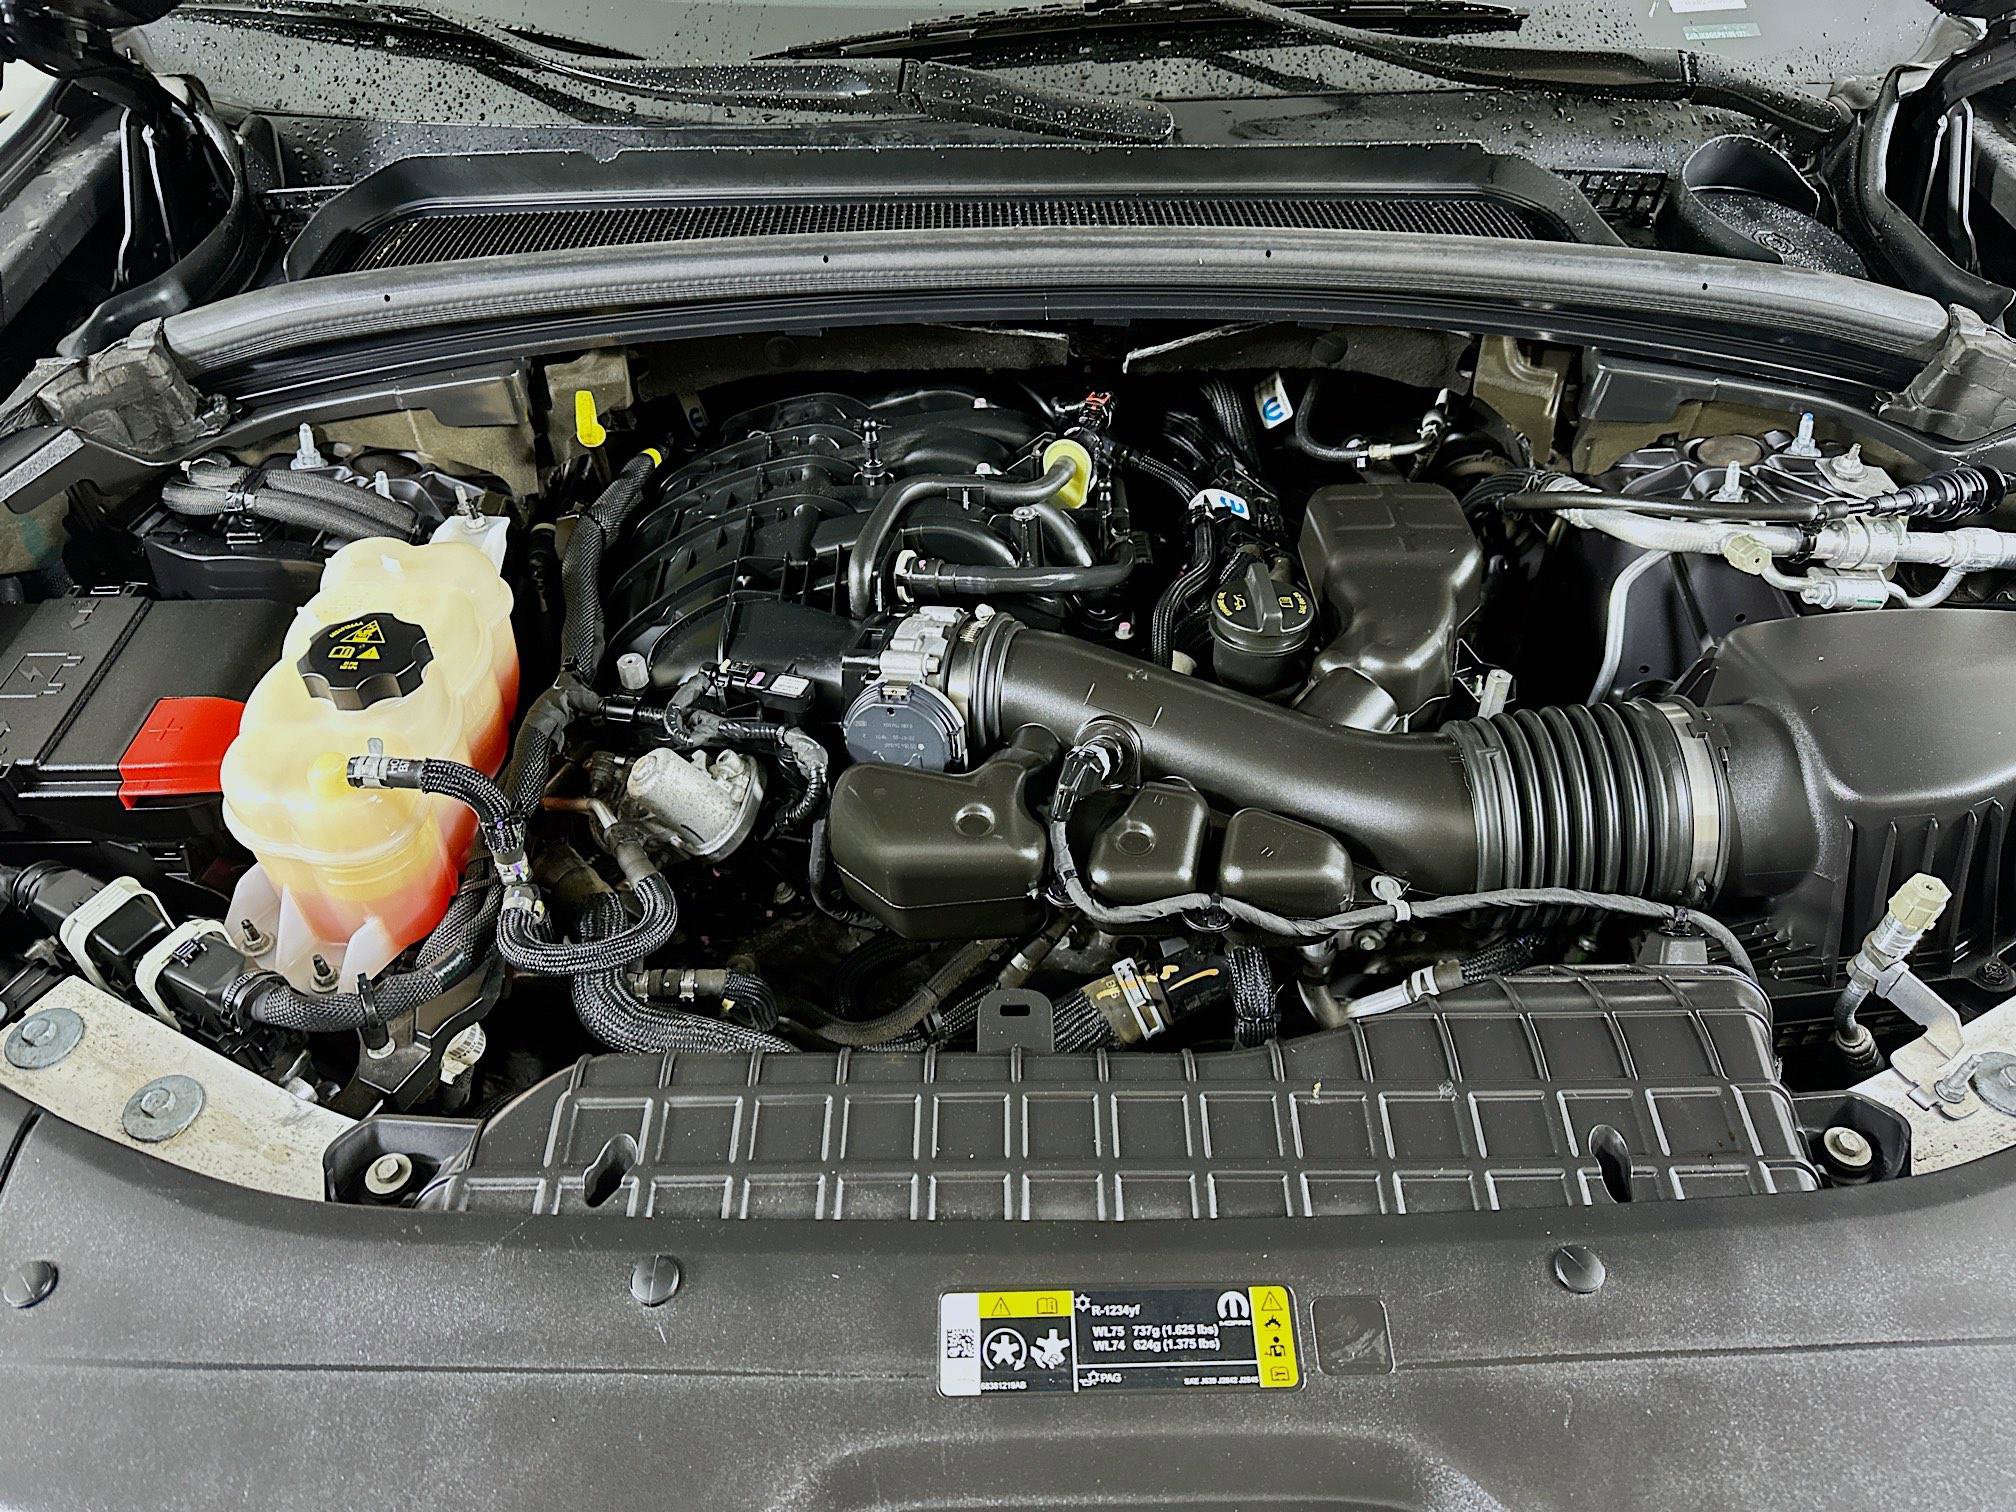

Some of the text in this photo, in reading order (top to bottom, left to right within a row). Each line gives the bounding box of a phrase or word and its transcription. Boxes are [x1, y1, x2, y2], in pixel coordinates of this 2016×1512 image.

[1091, 1304, 1141, 1317] R-1234yf
[1092, 1323, 1219, 1338] WL75 737g (1.625 lbs)
[1093, 1338, 1221, 1353] WL74 624g (1.375 lbs)
[1100, 1373, 1122, 1384] PAG
